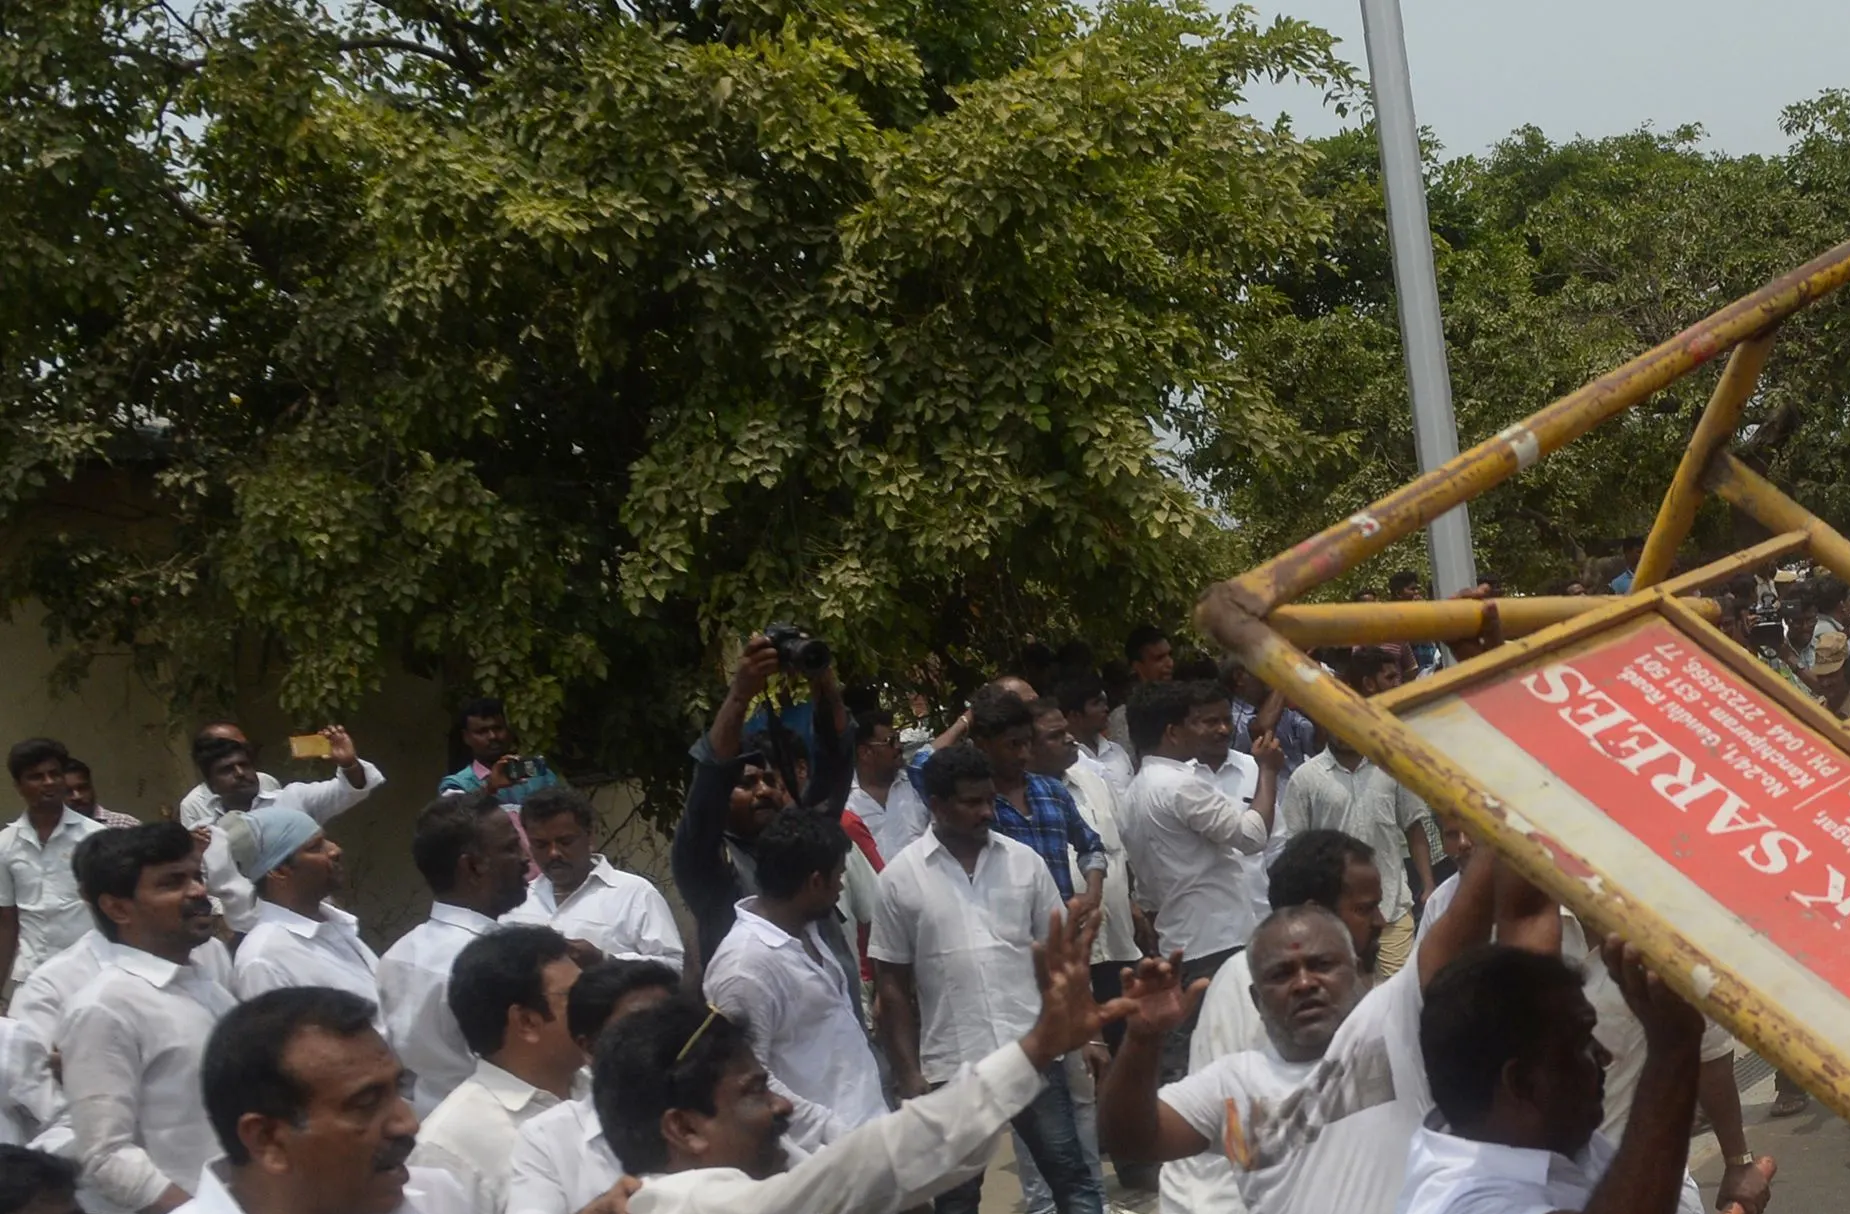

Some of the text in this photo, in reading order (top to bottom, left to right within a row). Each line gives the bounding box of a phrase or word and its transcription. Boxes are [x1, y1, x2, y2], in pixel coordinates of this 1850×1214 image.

[1654, 643, 1684, 661] 77
[1634, 654, 1670, 679] 501
[1665, 677, 1701, 702] 631
[1659, 701, 1721, 746] Gandhi
[1709, 707, 1815, 789] Kanchipuram
[1766, 724, 1804, 751] 044
[1520, 663, 1812, 874] SAREES
[1807, 753, 1840, 777] PH
